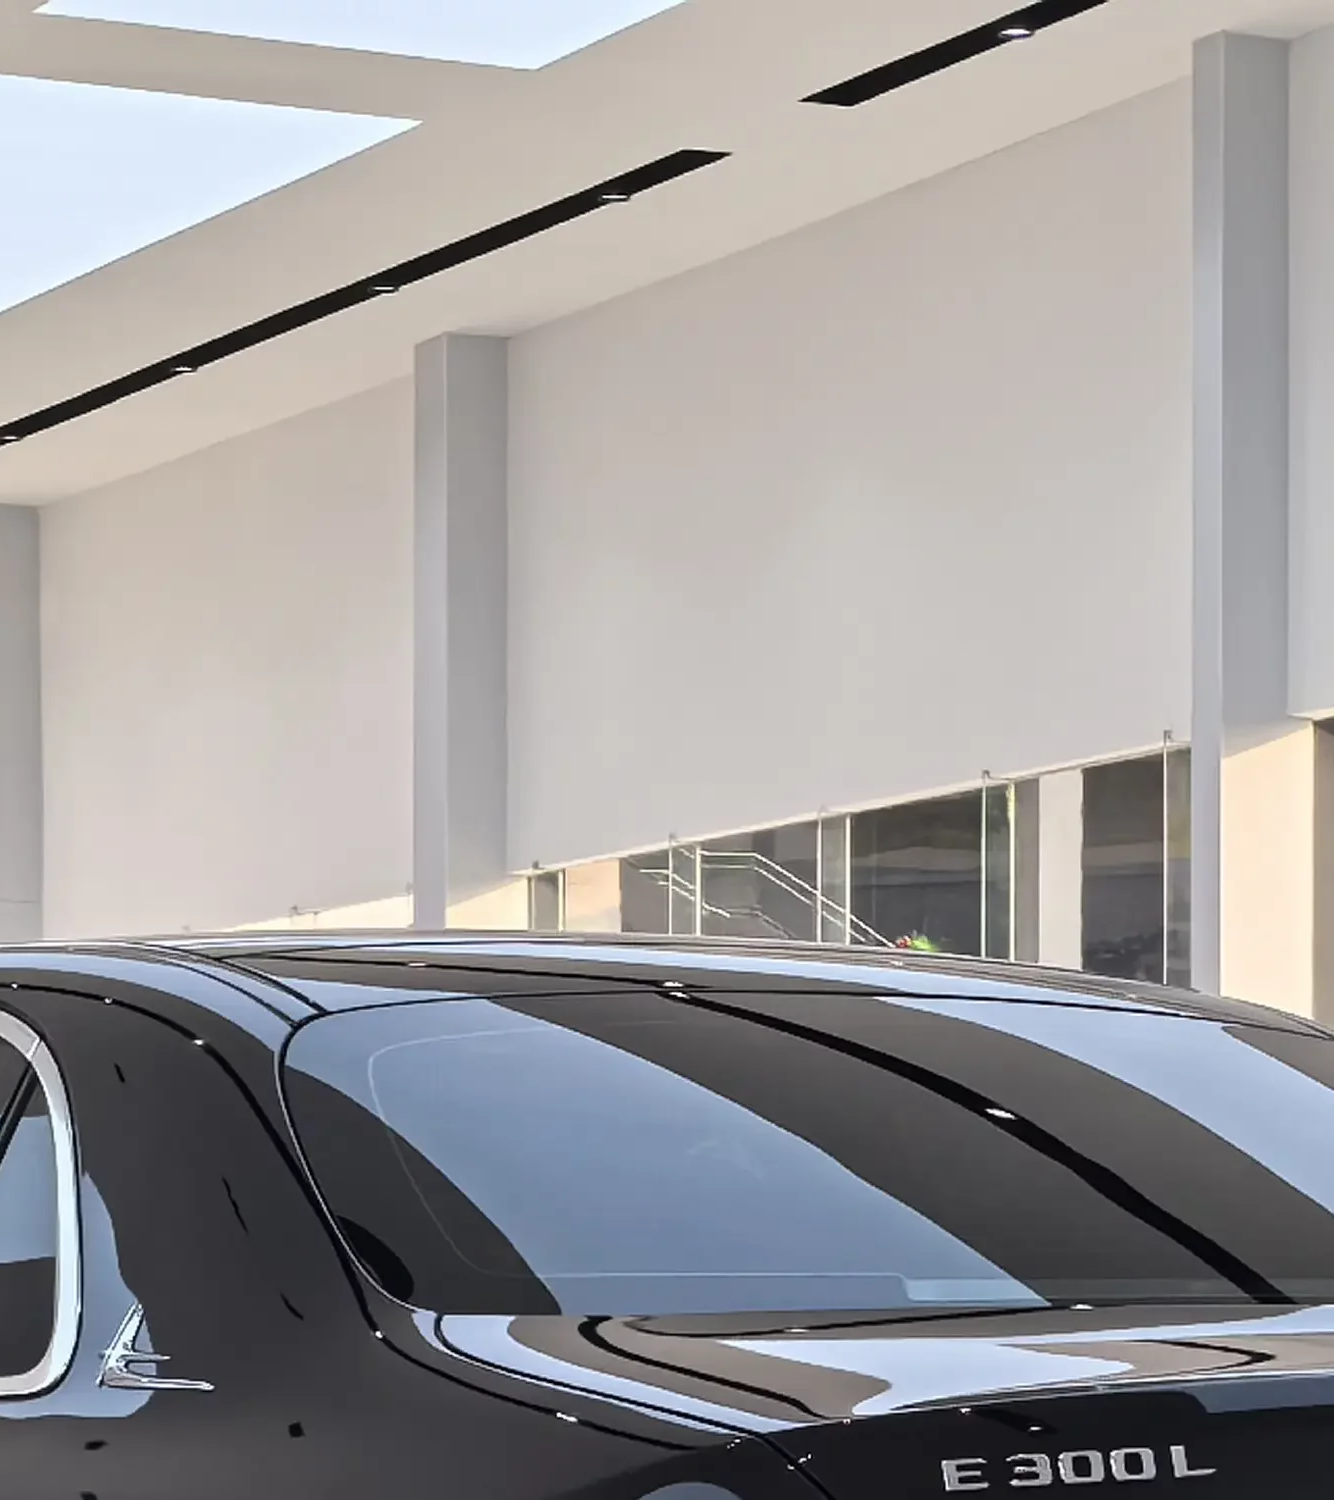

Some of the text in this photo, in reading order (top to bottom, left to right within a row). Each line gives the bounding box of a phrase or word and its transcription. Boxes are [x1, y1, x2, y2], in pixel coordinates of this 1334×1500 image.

[941, 1445, 1217, 1491] E 300 L
